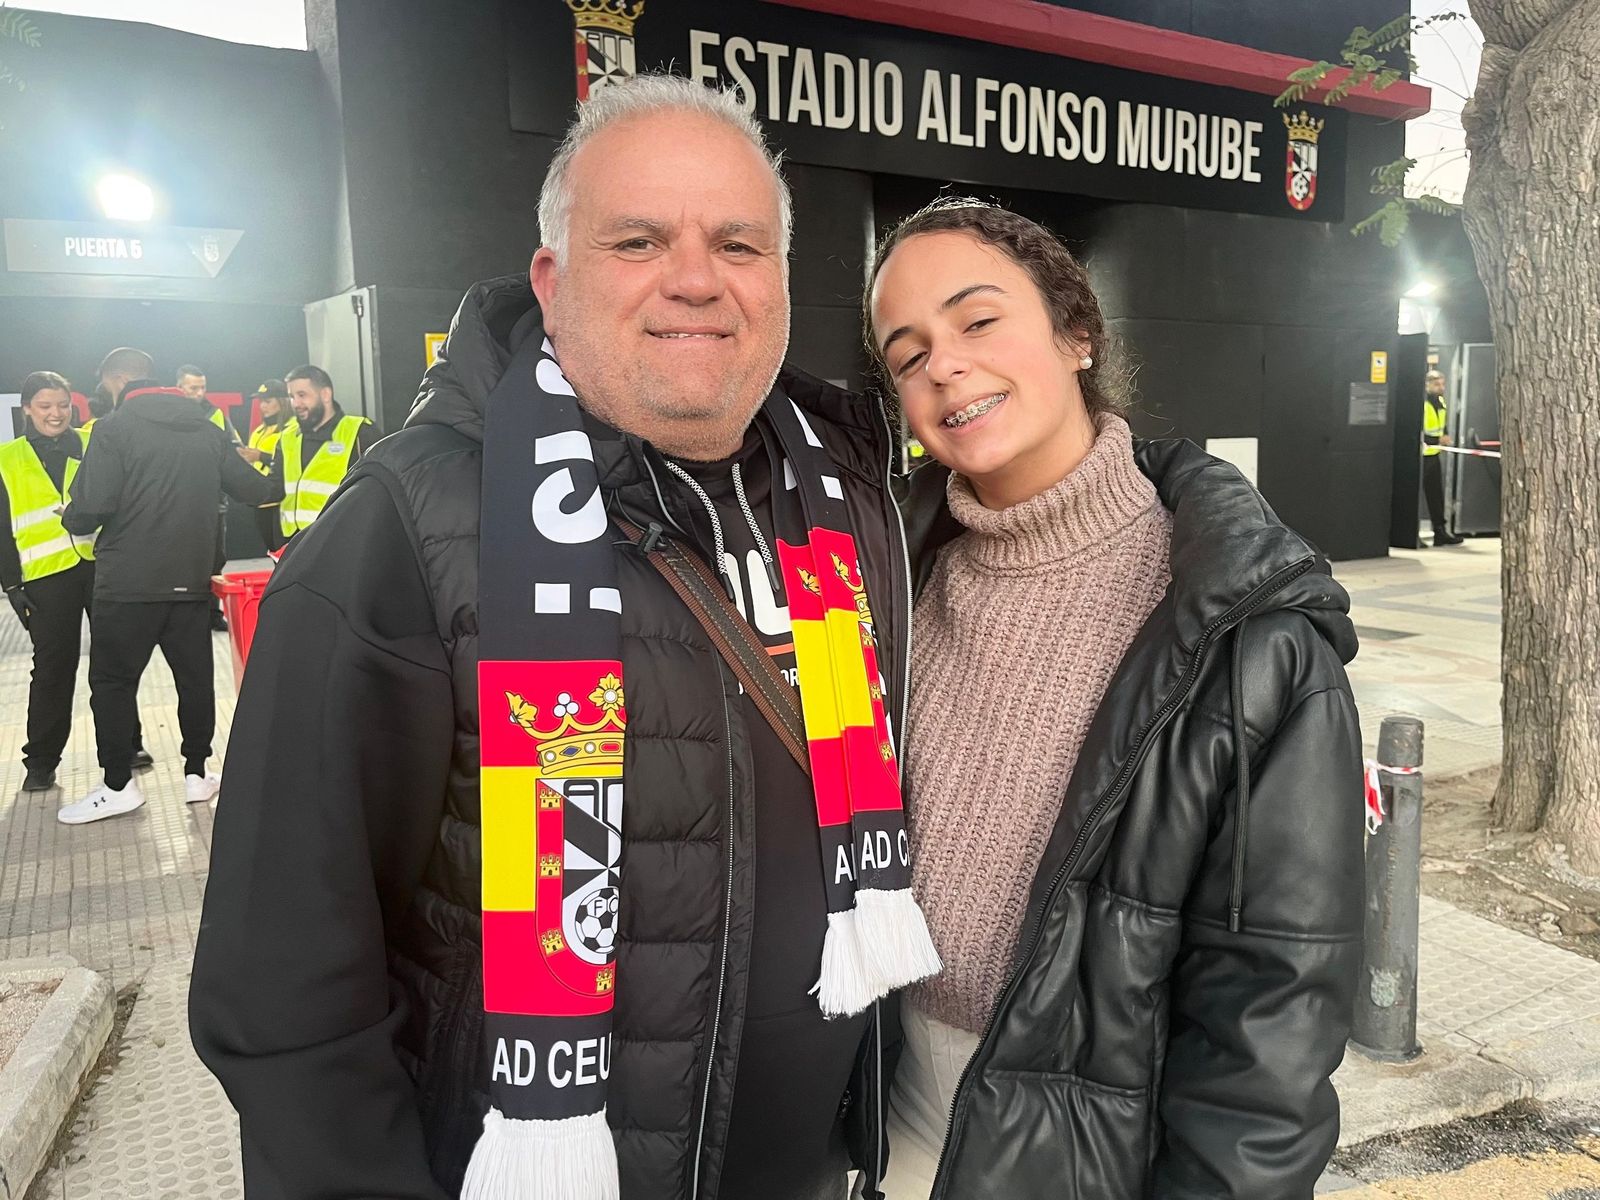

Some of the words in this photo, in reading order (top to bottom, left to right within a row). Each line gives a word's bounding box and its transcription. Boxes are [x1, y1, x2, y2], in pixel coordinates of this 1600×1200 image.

[917, 69, 1107, 164] ALFONSO
[1117, 101, 1264, 183] MURUBE
[64, 237, 128, 258] PUERTA
[834, 843, 857, 884] A
[860, 830, 892, 870] AD
[897, 828, 911, 868] C
[492, 1037, 536, 1087] AD
[547, 1032, 612, 1088] CEU
